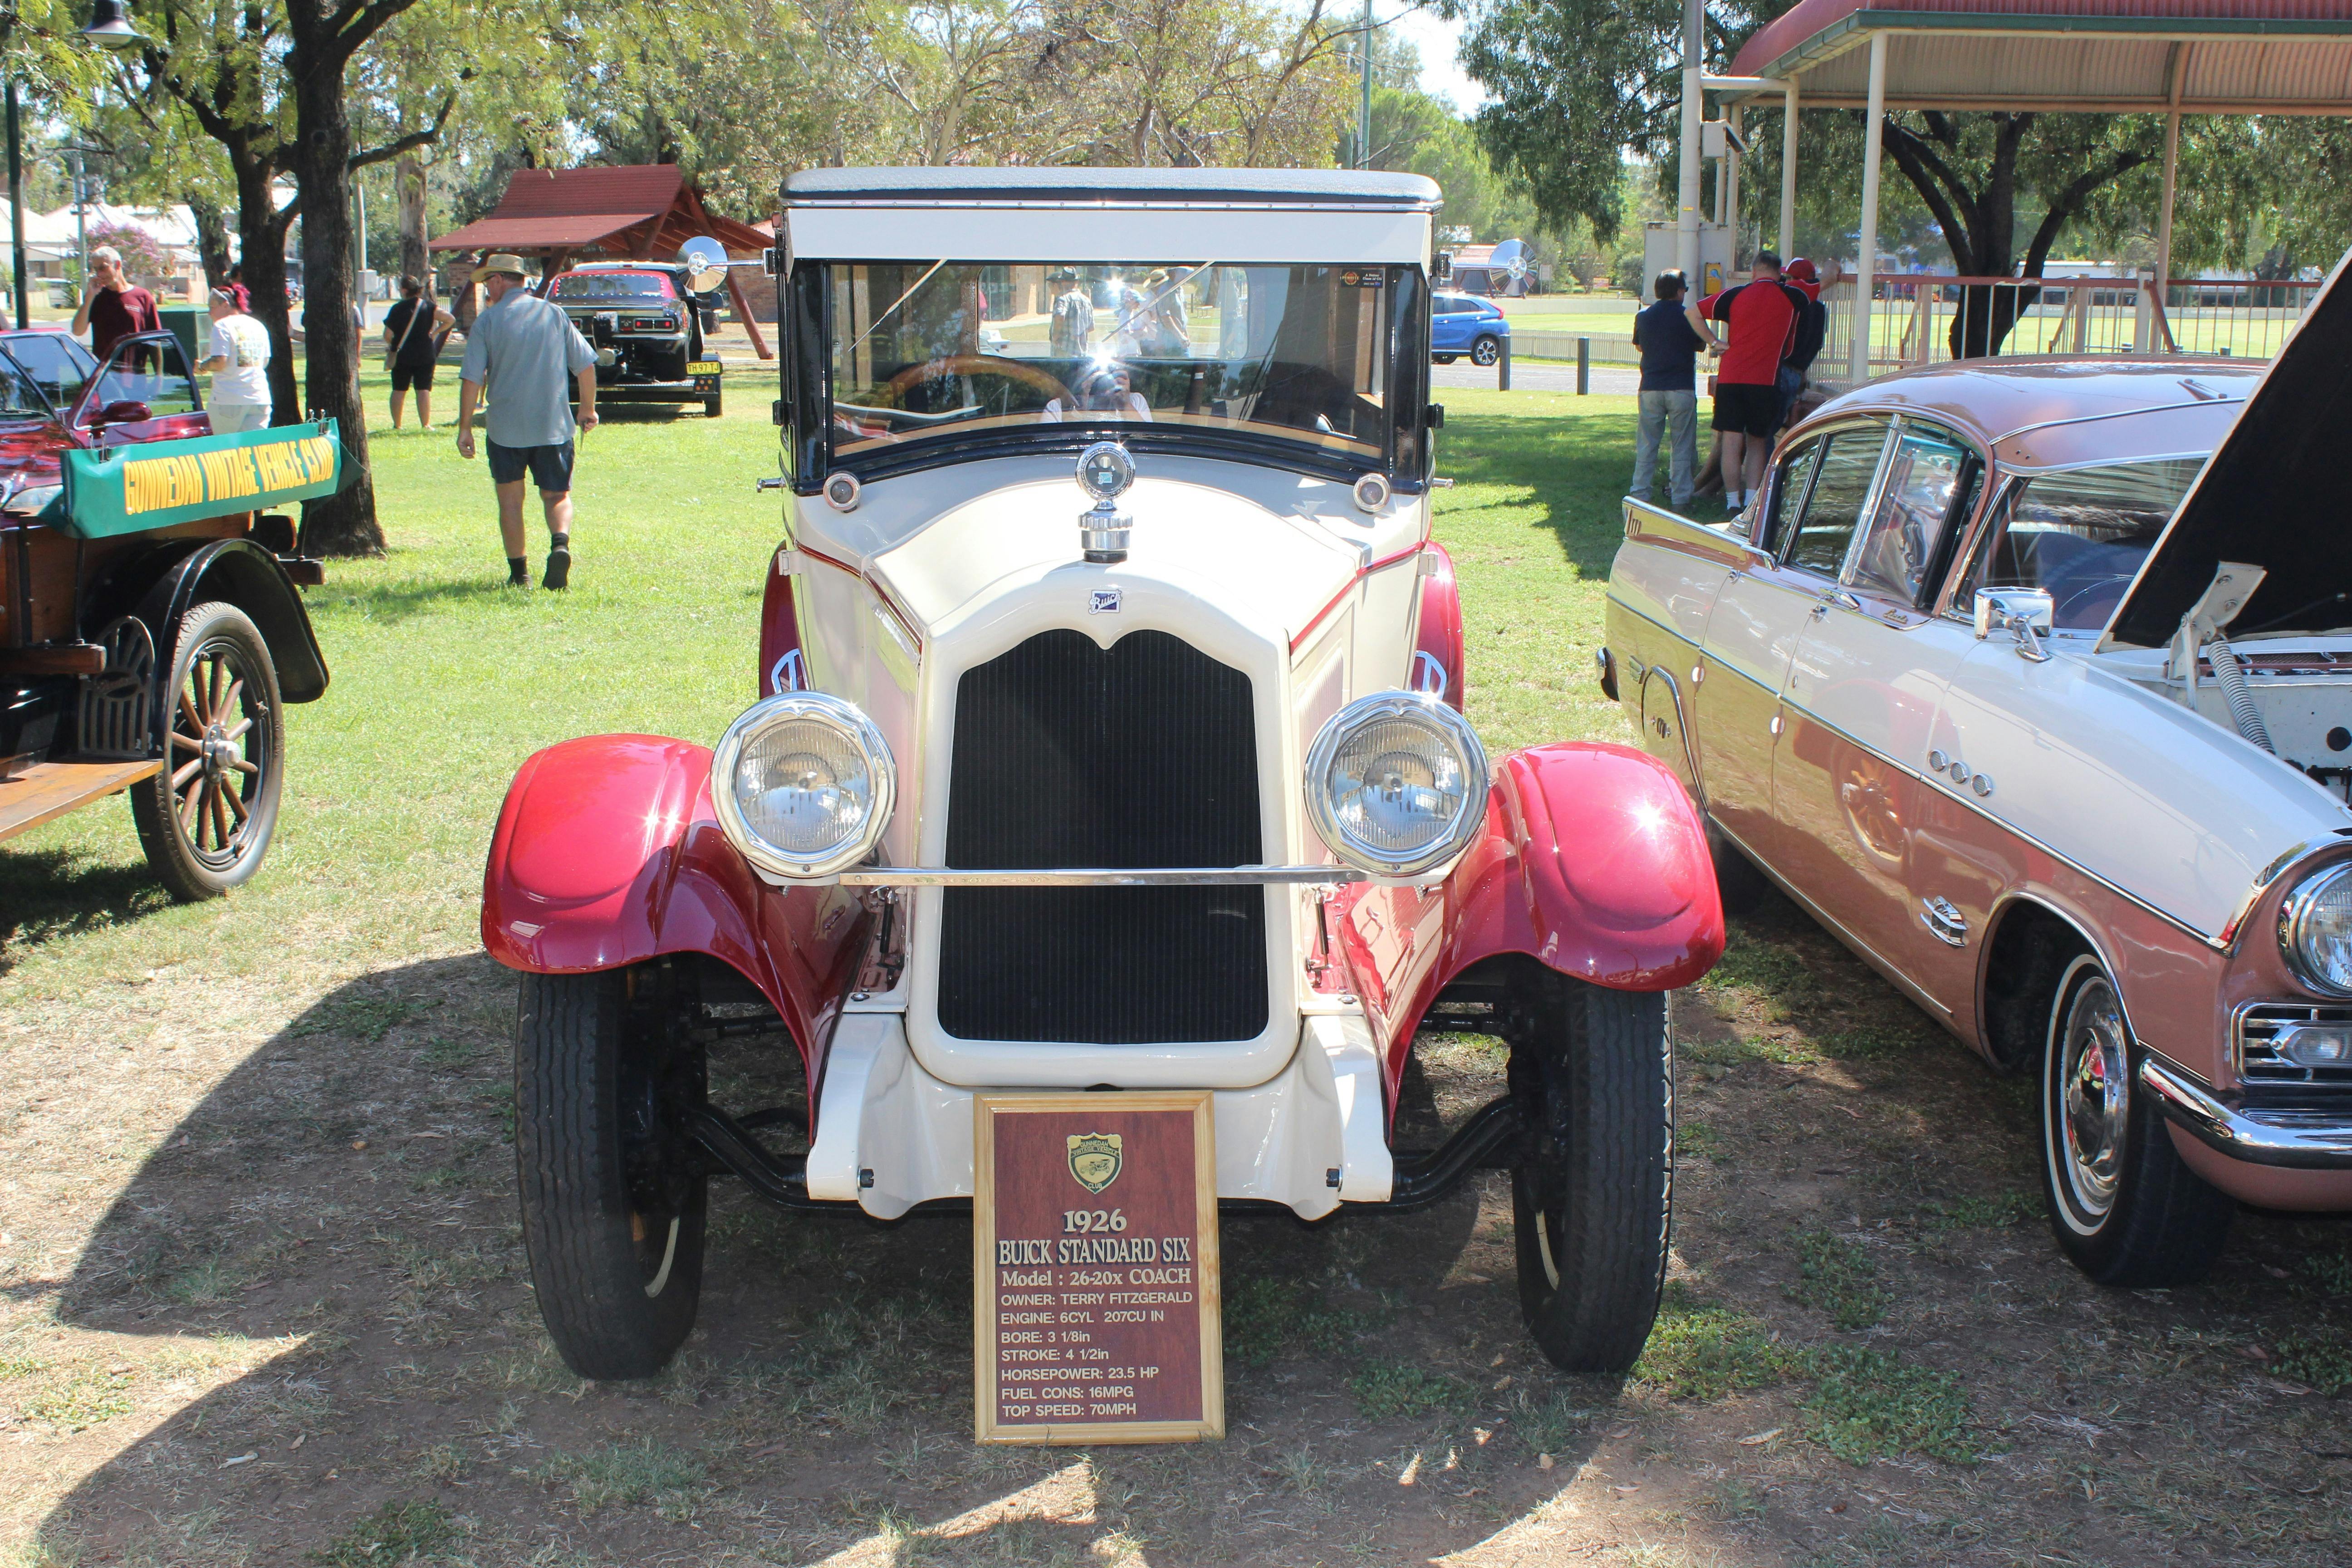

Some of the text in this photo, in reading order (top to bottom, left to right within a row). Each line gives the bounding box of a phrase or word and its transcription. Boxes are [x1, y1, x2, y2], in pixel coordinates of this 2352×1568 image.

[123, 436, 334, 515] GUNNEDAH VINTAGE VEHICLE CLUB
[1089, 589, 1122, 615] Buick
[1080, 1140, 1108, 1148] GUNNEDAH
[1073, 1147, 1118, 1156] VINTAGE VEHICLE
[1064, 1208, 1127, 1234] 1926
[999, 1237, 1191, 1264] BUICK STANDARD SIX
[1069, 1270, 1123, 1286] 26-20x
[1129, 1268, 1191, 1284] COACH
[1001, 1292, 1193, 1306] OWNER: TERRY FITZGERALD
[1001, 1310, 1164, 1324] ENGINE: 6CYL 207CU IN
[1001, 1331, 1090, 1343] BORE: 3 1/8in
[1001, 1348, 1109, 1362] STROKE: 4 1/2in
[1001, 1367, 1159, 1381] HORSEPOWER: 23.5 HP
[1002, 1386, 1134, 1400] FUEL CONS: 16MPG
[1002, 1402, 1136, 1417] TOP SPEED: 70MPH
